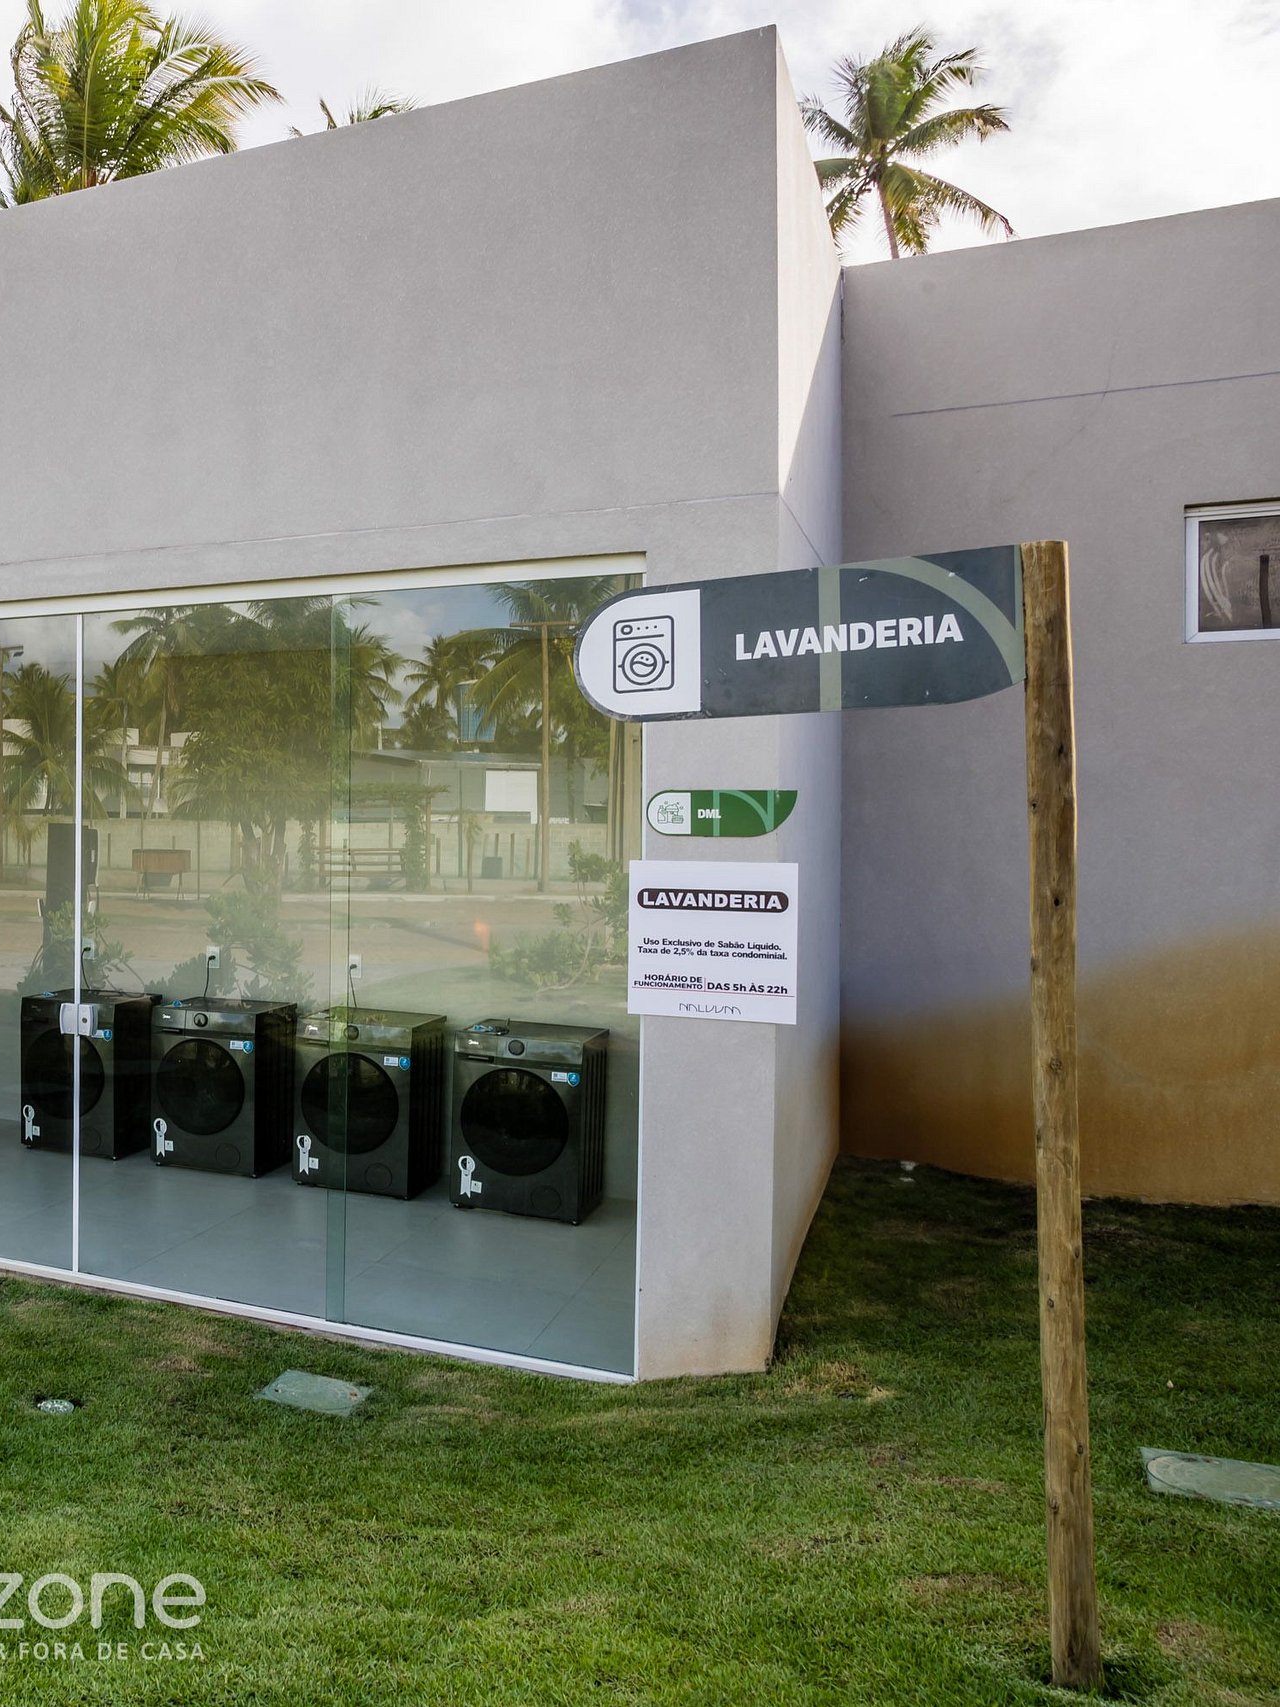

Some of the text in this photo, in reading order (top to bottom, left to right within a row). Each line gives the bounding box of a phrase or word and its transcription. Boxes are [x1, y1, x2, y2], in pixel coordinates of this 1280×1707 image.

[735, 613, 963, 660] LAVANDERIA
[698, 809, 721, 819] DML
[643, 892, 782, 909] LAVANDERIA
[662, 938, 701, 947] Exclusivo
[718, 941, 744, 949] Sabão
[748, 942, 781, 951] Líquido.
[638, 946, 658, 954] Taxa
[661, 947, 670, 955] de
[673, 948, 694, 956] 2,5%
[732, 951, 787, 960] condominial.
[644, 973, 688, 982] HORÁRIO
[634, 981, 703, 989] FUNCIONAMENTO
[707, 982, 788, 994] DAS 5h ÀS 22h
